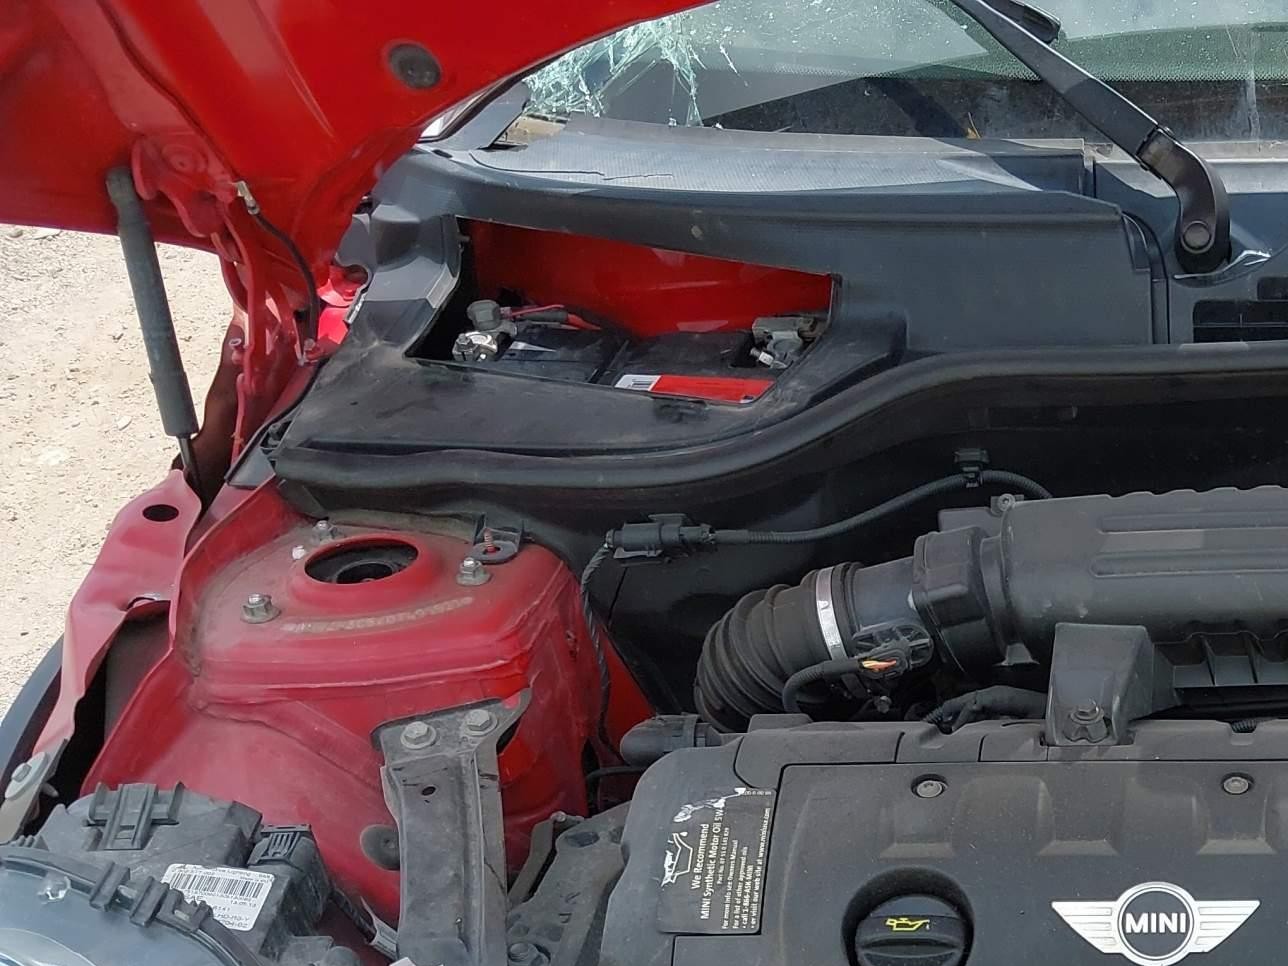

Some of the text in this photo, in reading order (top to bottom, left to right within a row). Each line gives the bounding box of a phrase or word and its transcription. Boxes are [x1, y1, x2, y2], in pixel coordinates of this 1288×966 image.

[712, 823, 721, 832] Oil
[690, 824, 709, 889] We Recommend
[708, 835, 719, 858] Motor
[730, 840, 738, 859] Manual
[703, 860, 716, 896] Synthetic
[745, 865, 753, 879] MINI
[700, 898, 710, 919] MINI
[1125, 912, 1186, 934] MINI
